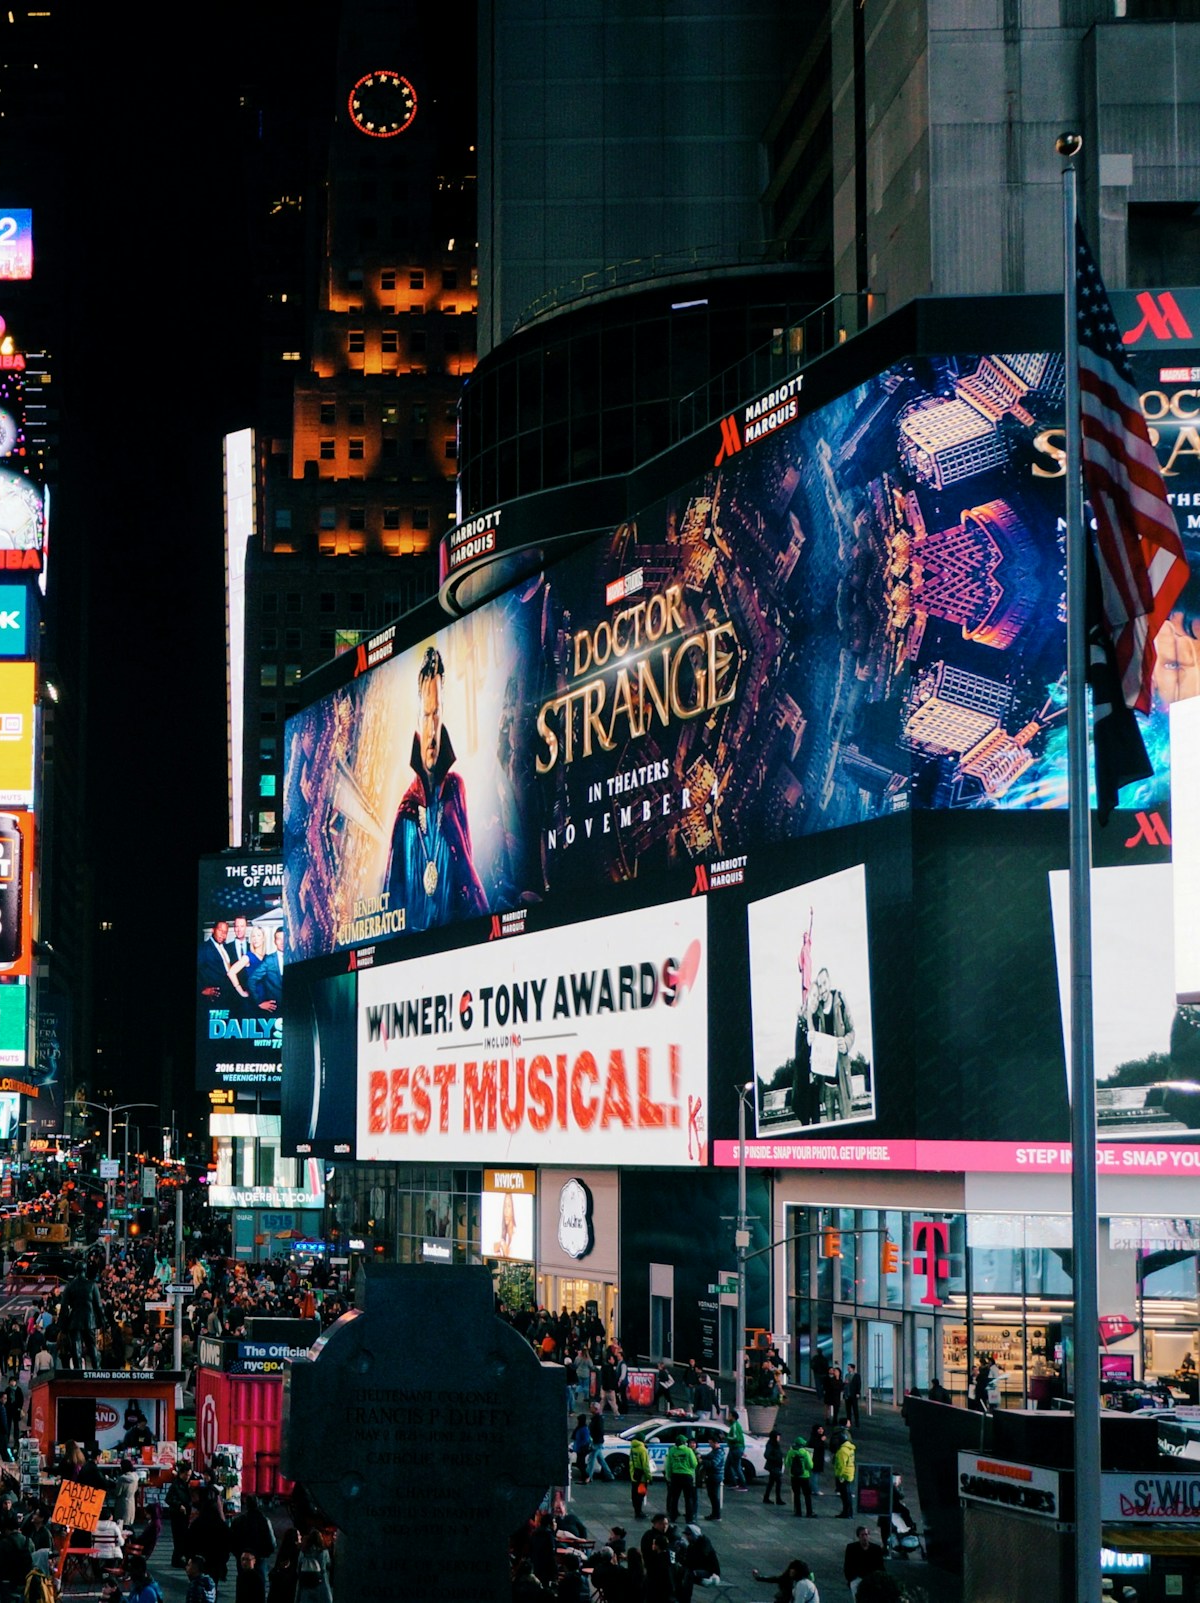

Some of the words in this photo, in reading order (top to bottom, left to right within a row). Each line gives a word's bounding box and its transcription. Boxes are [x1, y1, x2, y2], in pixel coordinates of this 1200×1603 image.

[745, 375, 803, 420] MARRIOTT
[745, 403, 797, 442] MARQUIS
[451, 510, 501, 548] MARRIOTT
[451, 533, 494, 568] MARQUIS
[368, 626, 396, 651] MARRIOTT
[574, 585, 685, 677] DOCTOR
[536, 621, 736, 774] STRANGE
[588, 778, 602, 803] IN
[607, 758, 669, 798] THEATERS
[548, 789, 691, 850] NOVEMBER
[226, 866, 247, 878] THE
[250, 863, 284, 877] SERIE
[710, 855, 747, 875] MARRIOTT
[243, 876, 260, 888] OF
[710, 870, 744, 888] MARQUIS
[354, 892, 390, 919] BENEDICT
[502, 909, 528, 925] MARRIOTT
[338, 908, 406, 946] CUMBERBATCH
[502, 921, 525, 935] MARQUIS
[366, 993, 454, 1043] WINNER!
[459, 990, 473, 1030] 6
[479, 978, 548, 1027] TONY
[553, 957, 682, 1019] AWARDS
[209, 1010, 230, 1020] THE
[208, 1018, 276, 1039] DAILY
[484, 1036, 522, 1049] INCLUDING
[215, 1063, 234, 1073] 2016
[235, 1062, 274, 1074] ELECTION
[223, 1073, 266, 1082] WEEKNIGHTS
[367, 1063, 457, 1135] BEST
[463, 1044, 684, 1135] MUSICAL!
[750, 1146, 773, 1159] INSIDE.
[774, 1146, 790, 1159] SNAP
[790, 1146, 812, 1159] YOUR
[812, 1146, 839, 1160] PHOTO.
[840, 1146, 856, 1160] GET
[856, 1147, 867, 1160] UP
[867, 1147, 891, 1161] HERE.
[1016, 1148, 1057, 1165] STEP
[1123, 1149, 1164, 1167] SNAP
[1168, 1150, 1200, 1167] YOU
[494, 1172, 525, 1189] INVICTA
[262, 1215, 293, 1229] 1515
[244, 1346, 266, 1356] The
[269, 1346, 310, 1357] Official
[343, 1407, 424, 1425] FRANCIS
[448, 1408, 515, 1426] DUFFY
[366, 1453, 436, 1466] CATHOLIC
[441, 1453, 493, 1466] PRIEST
[60, 1480, 97, 1504] ABIDE
[70, 1498, 82, 1511] IN
[54, 1505, 98, 1532] CHRIST
